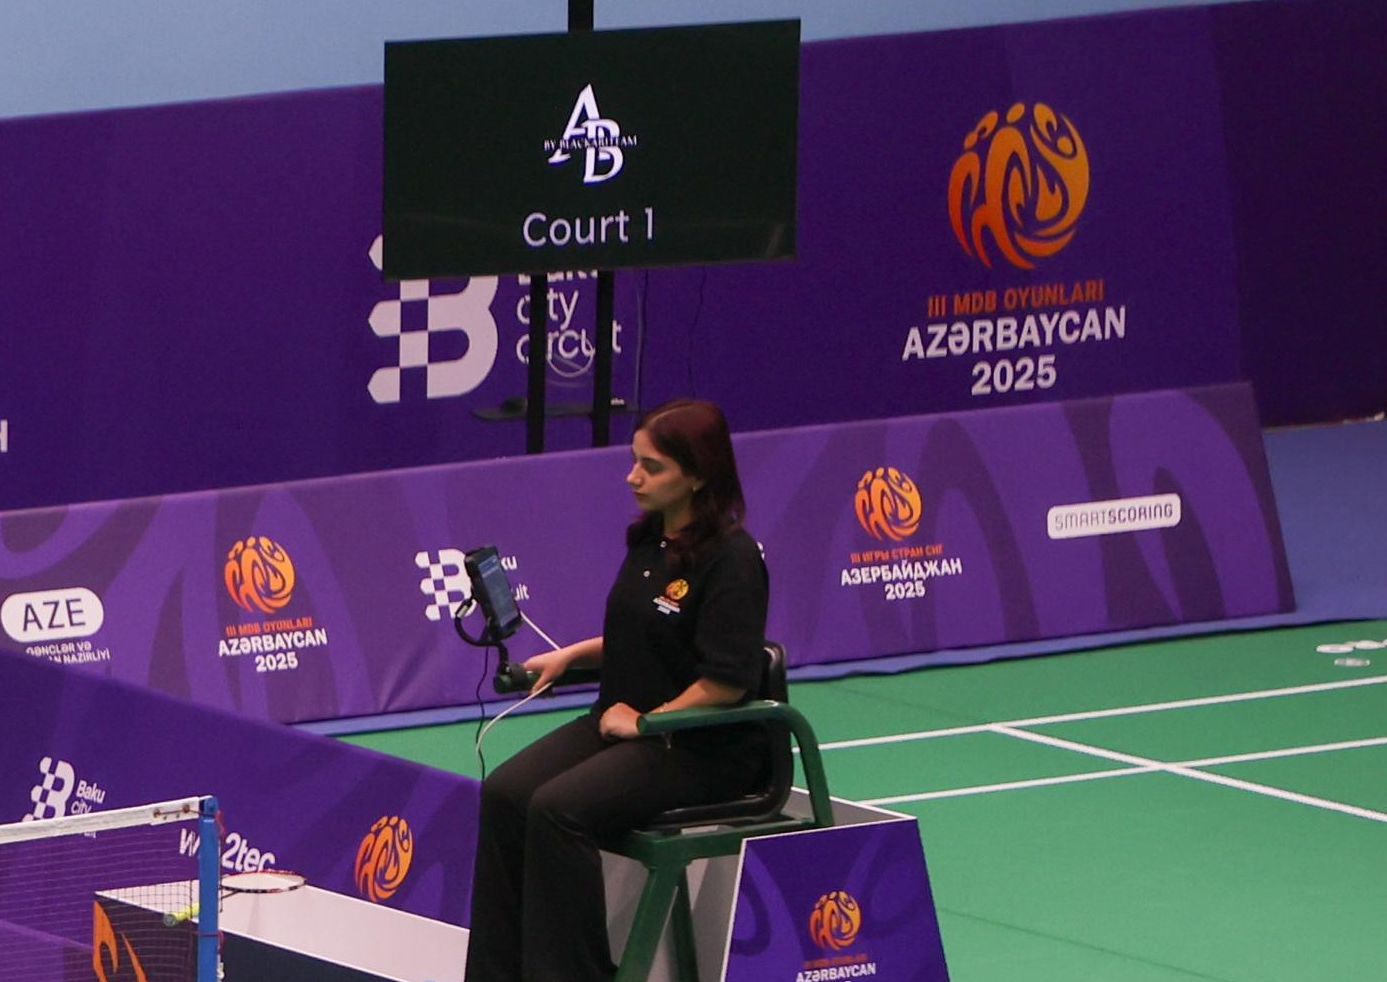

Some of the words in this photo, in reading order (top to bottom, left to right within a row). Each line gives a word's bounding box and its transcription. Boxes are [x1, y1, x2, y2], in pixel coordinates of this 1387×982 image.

[523, 210, 629, 247] Court
[644, 207, 654, 241] 1
[516, 288, 579, 331] cty
[928, 294, 946, 318] III
[953, 290, 997, 316] MDB
[1003, 278, 1105, 311] OYUNLARI
[901, 304, 1127, 362] AZƏRBAYCAN
[970, 353, 1057, 396] 2025
[1054, 503, 1174, 531] SMARTSCORING
[841, 557, 963, 586] АЗЕРБАЙДЖАН
[884, 580, 926, 600] 2025
[22, 598, 87, 632] AZE
[218, 627, 328, 658] AZƏRBAYCAN
[254, 651, 299, 673] 2025
[75, 779, 106, 805] Baku
